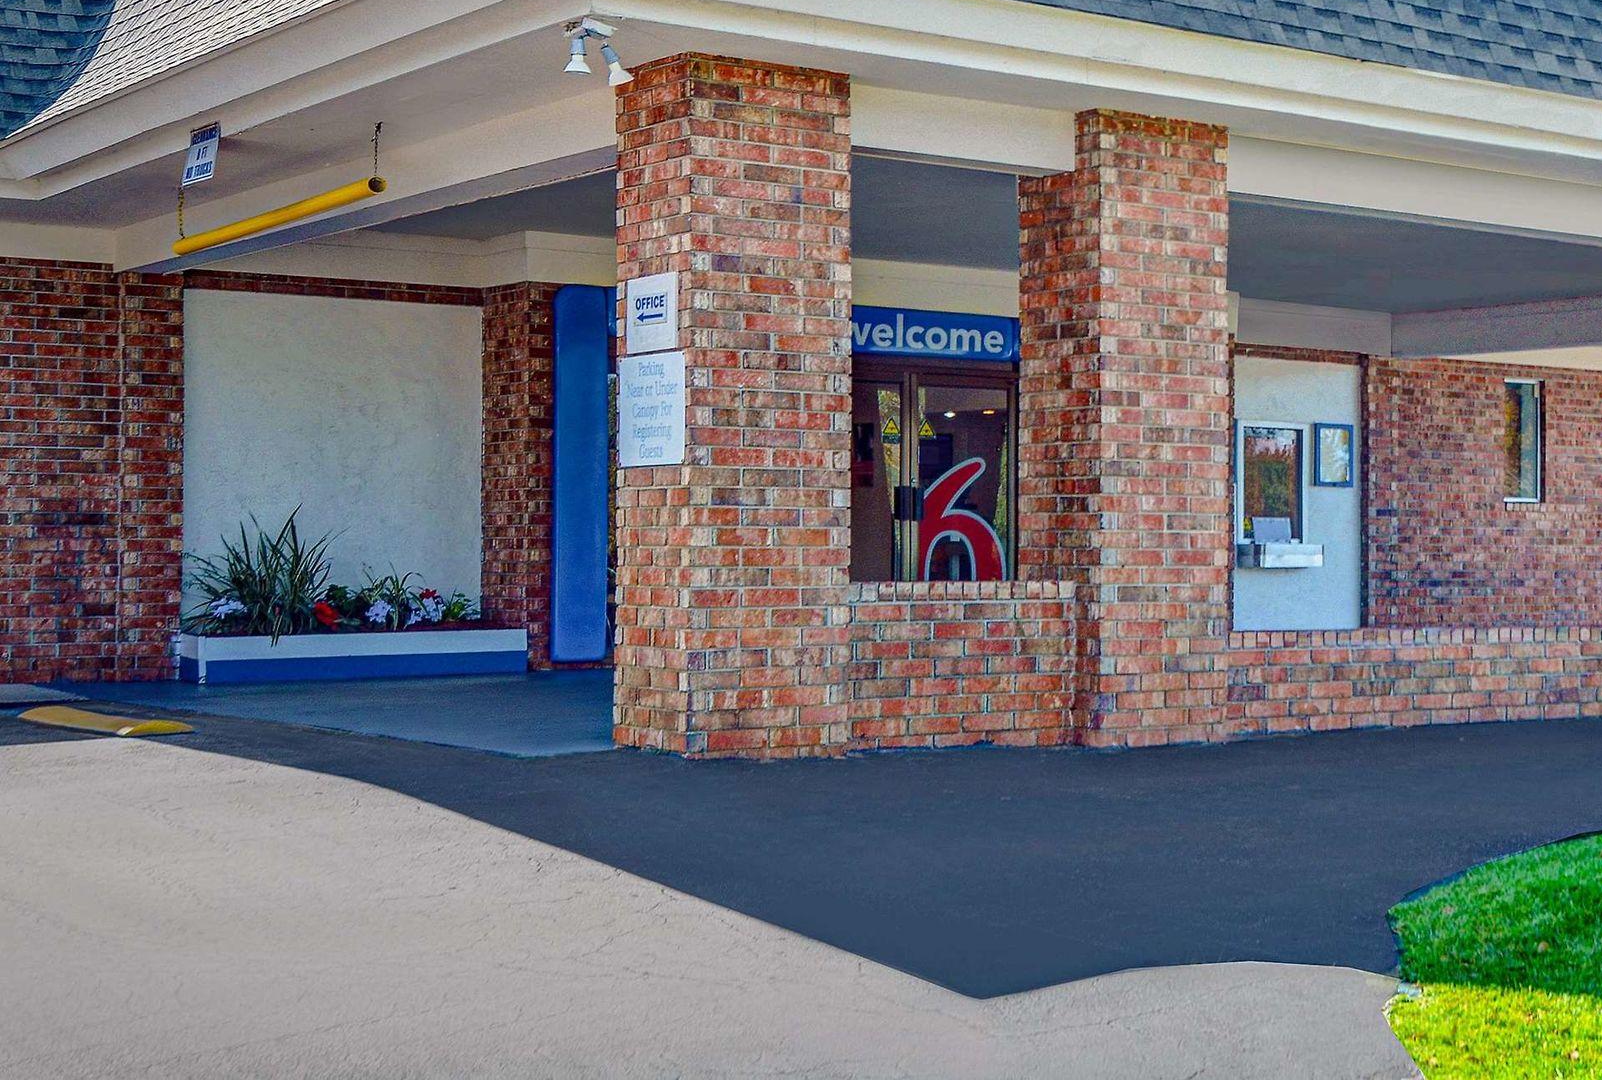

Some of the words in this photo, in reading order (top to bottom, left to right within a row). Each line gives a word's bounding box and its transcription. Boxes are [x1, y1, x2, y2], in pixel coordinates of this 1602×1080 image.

[635, 294, 665, 311] OFFICE
[638, 362, 665, 378] Parking
[626, 383, 644, 398] Near
[645, 385, 653, 396] or
[654, 381, 678, 397] Under
[632, 403, 659, 420] Canopy
[660, 401, 672, 416] For
[632, 423, 673, 442] Registering
[639, 444, 663, 459] Guests
